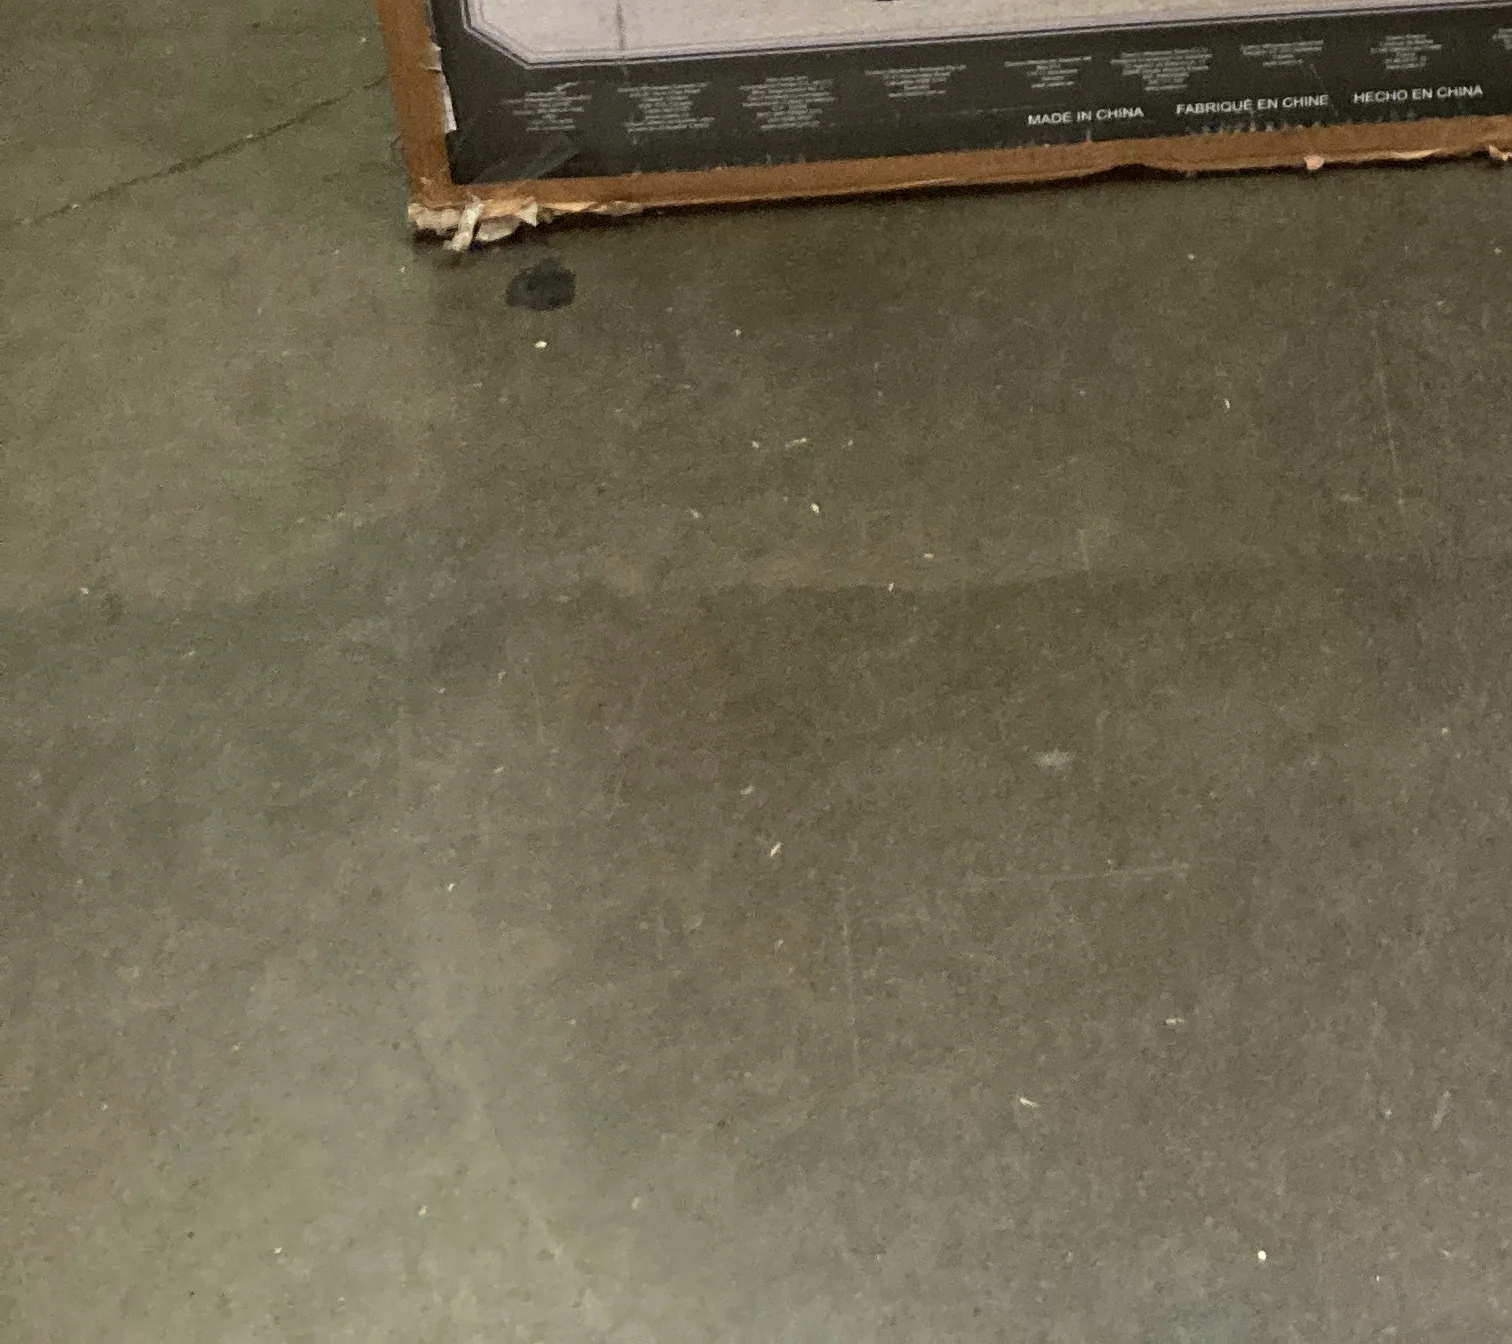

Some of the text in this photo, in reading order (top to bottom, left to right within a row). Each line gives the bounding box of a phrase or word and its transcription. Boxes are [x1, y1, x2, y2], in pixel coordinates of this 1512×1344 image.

[1258, 96, 1278, 111] EN
[1283, 94, 1329, 109] CHINE
[1354, 85, 1483, 104] HECHO EN CHINA
[1028, 106, 1144, 126] MADE IN CHINA
